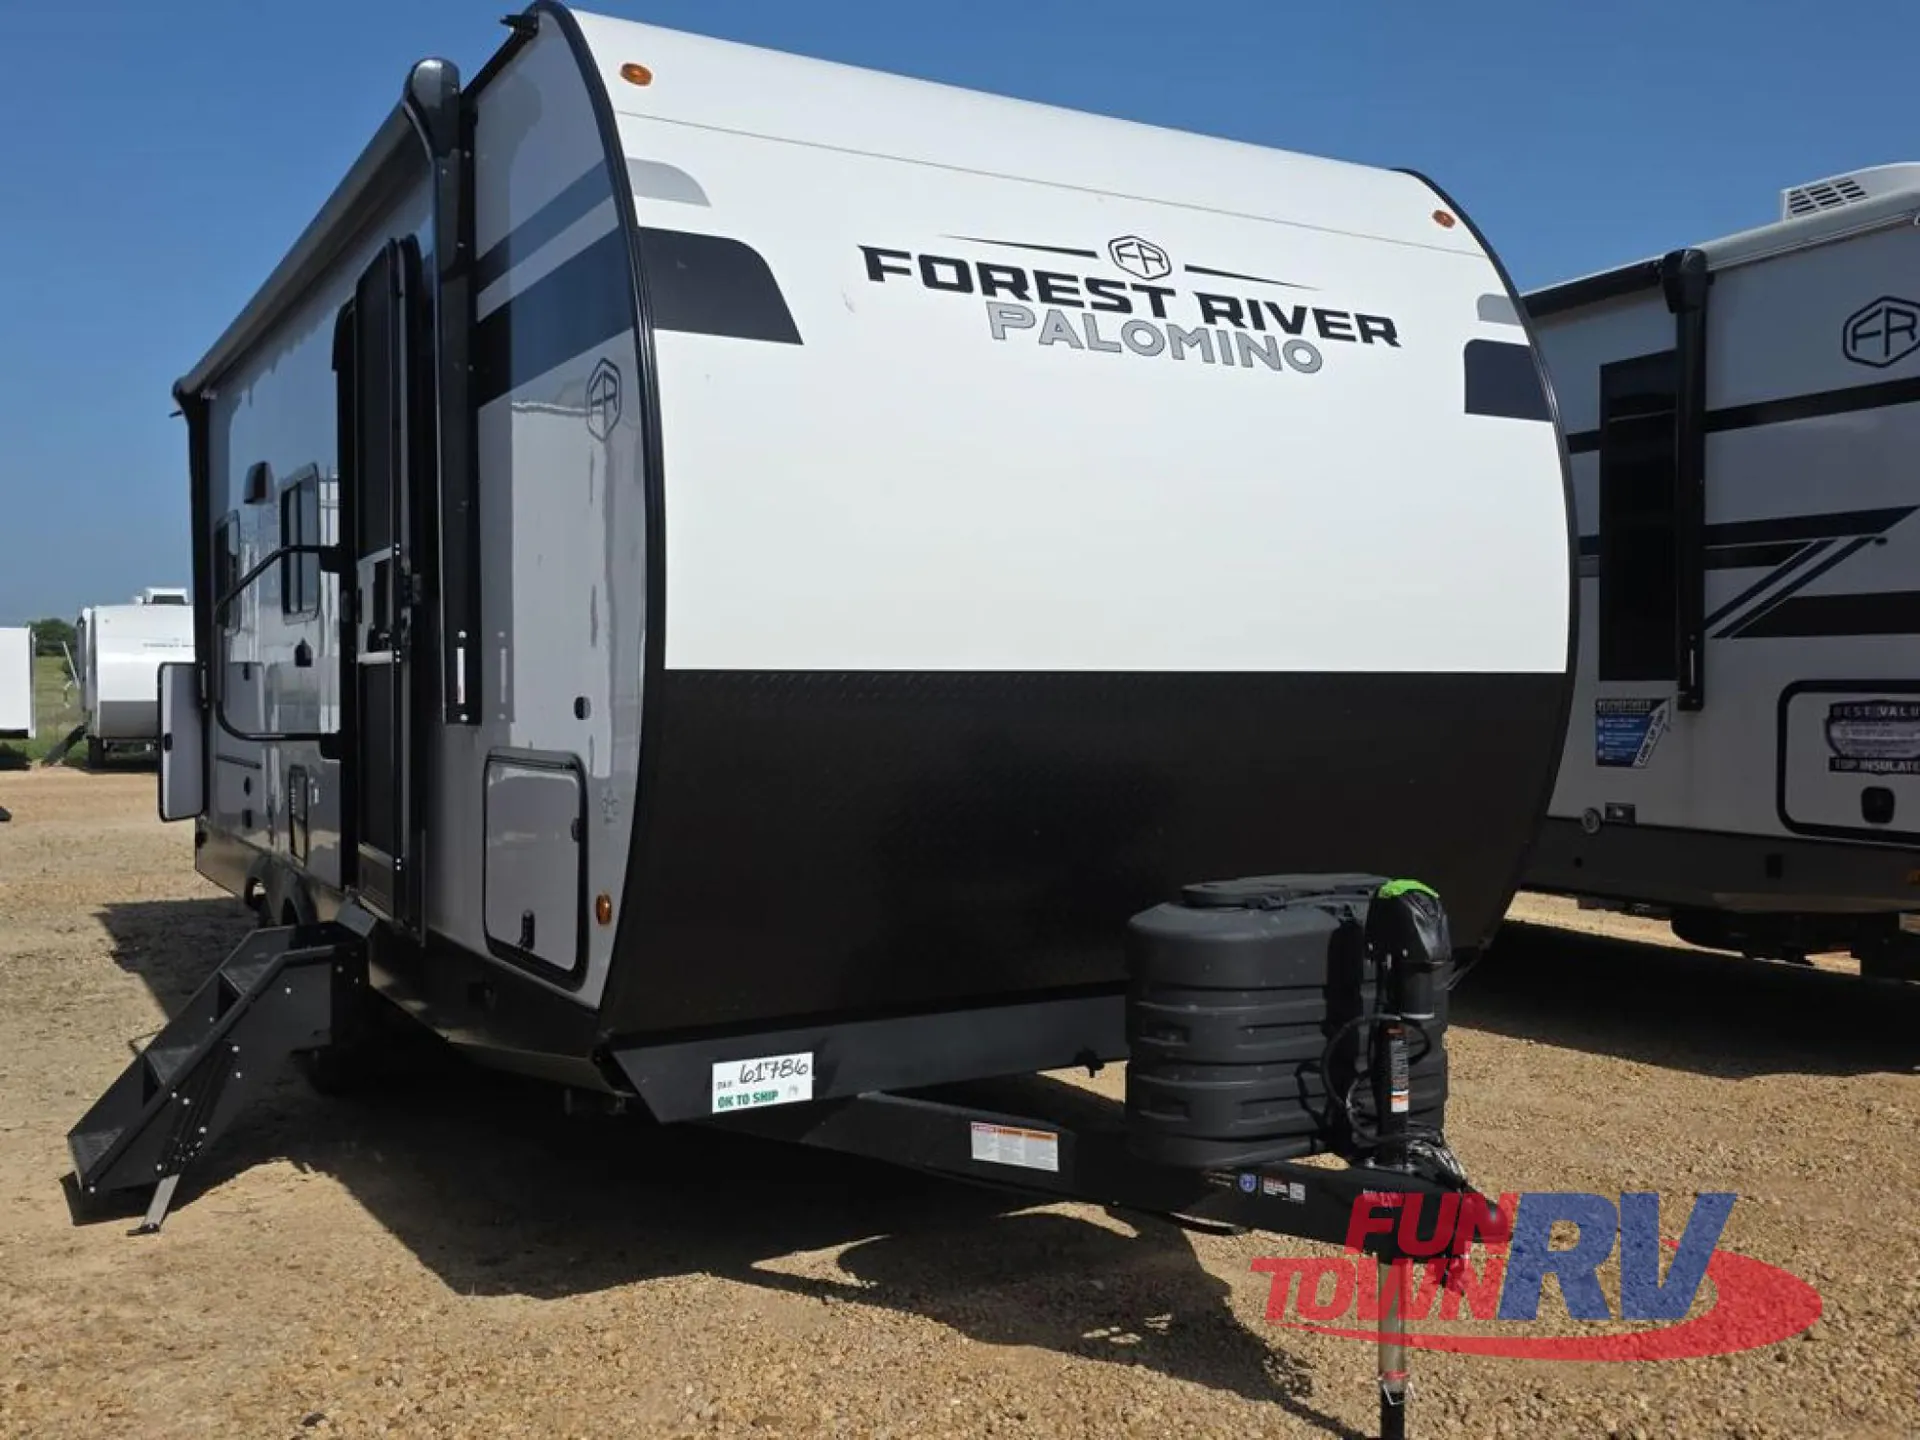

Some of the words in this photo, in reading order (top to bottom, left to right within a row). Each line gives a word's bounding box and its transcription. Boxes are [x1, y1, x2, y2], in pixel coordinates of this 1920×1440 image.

[857, 244, 1177, 319] FOREST
[1193, 291, 1402, 347] RIVER
[985, 300, 1323, 374] PALOMINO
[739, 1058, 809, 1085] 61786
[717, 1095, 734, 1109] OK
[737, 1093, 750, 1105] TO
[753, 1089, 779, 1103] SHIP
